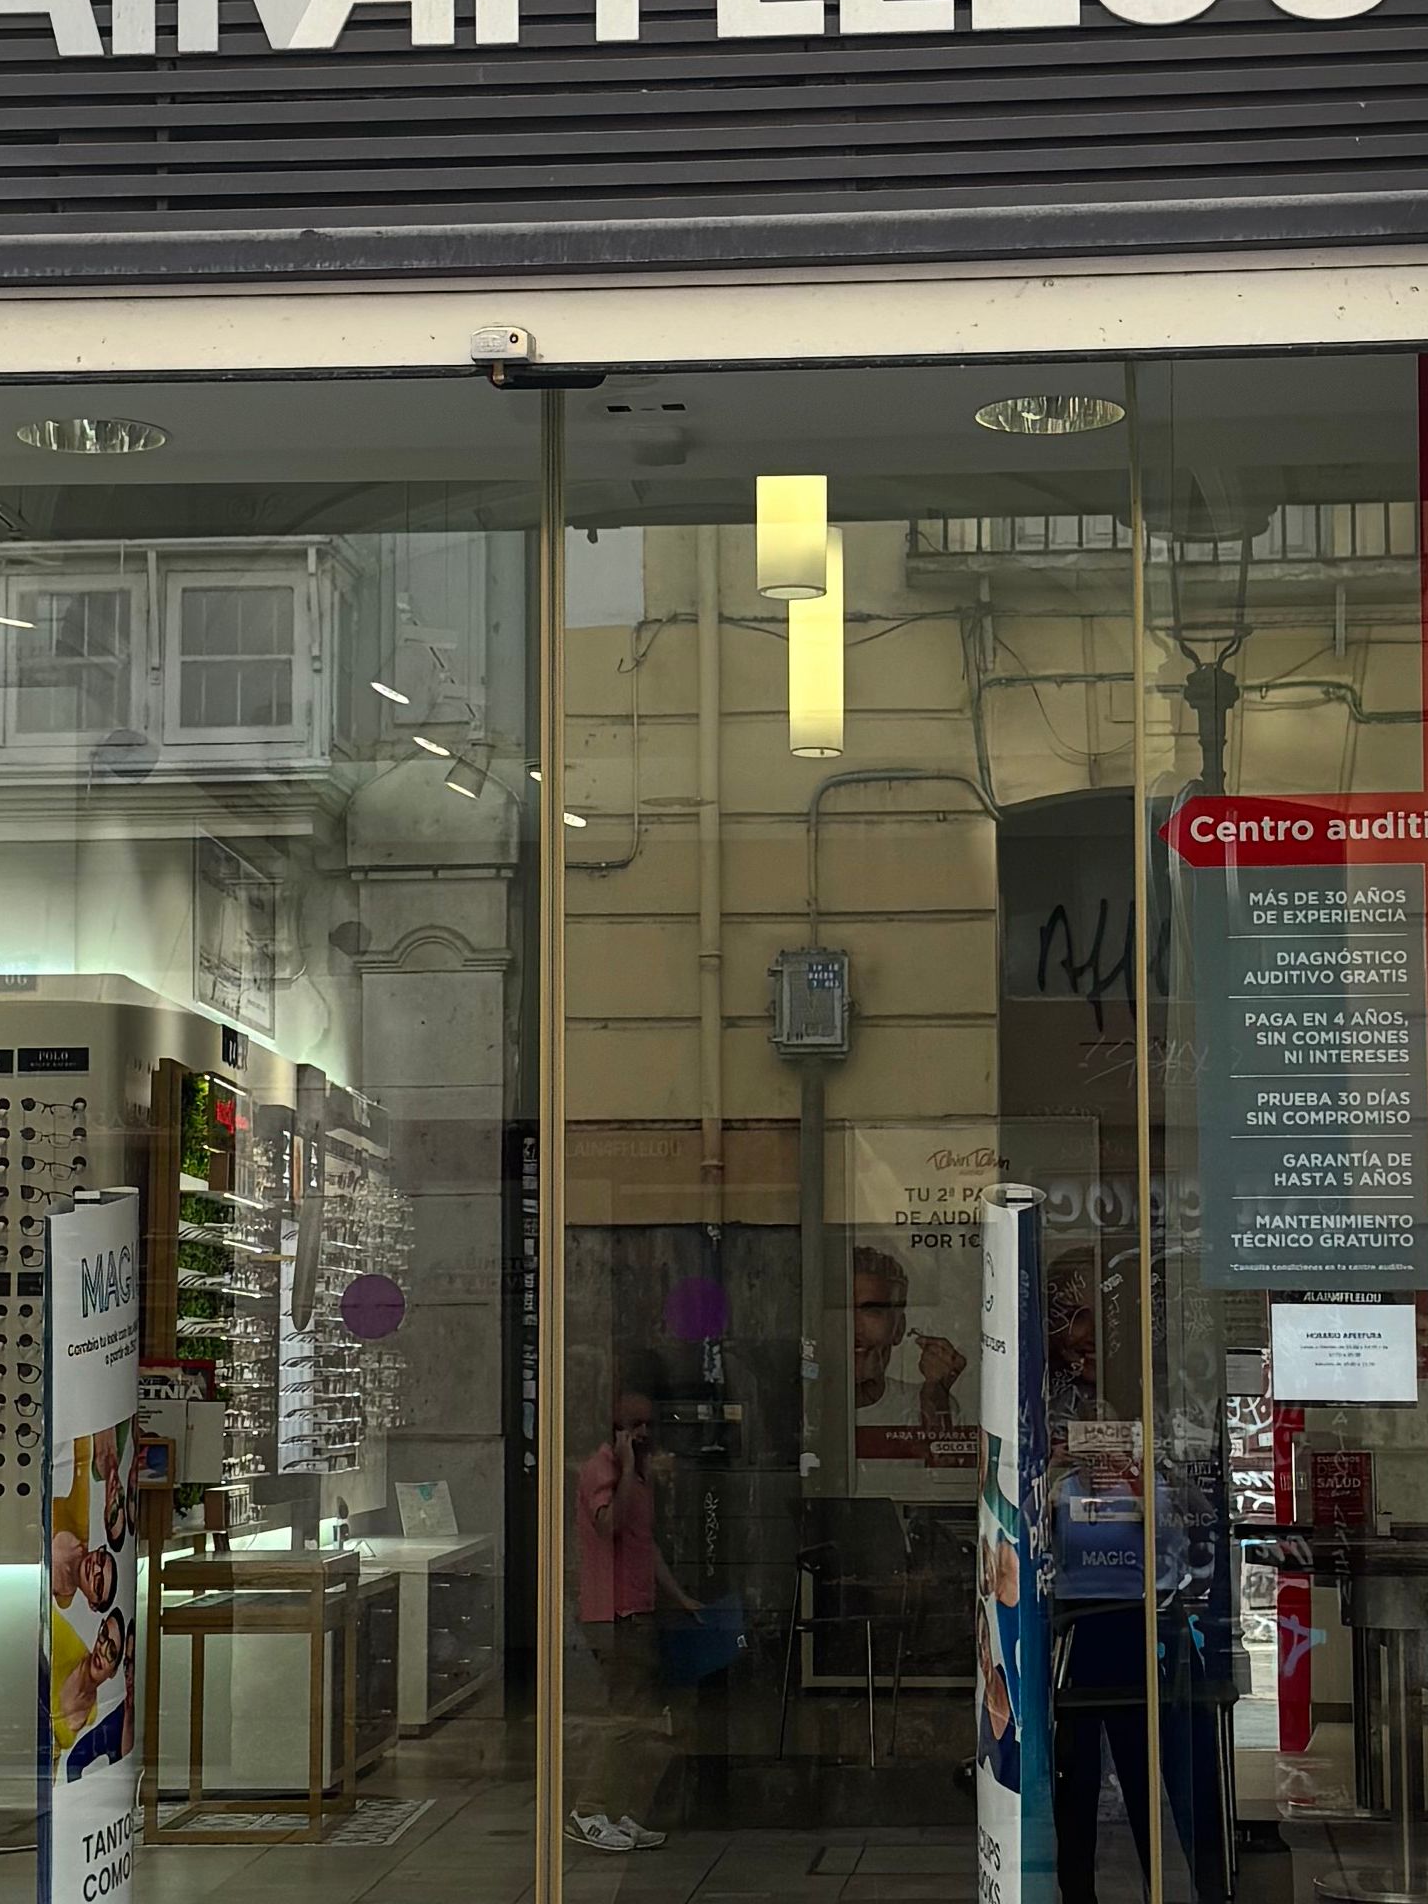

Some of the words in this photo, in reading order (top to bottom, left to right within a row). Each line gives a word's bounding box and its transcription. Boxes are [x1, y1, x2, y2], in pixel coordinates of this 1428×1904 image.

[1190, 815, 1314, 843] Centro
[1249, 889, 1288, 906] MÁS
[1294, 891, 1319, 905] DE
[1324, 891, 1348, 905] 30
[1353, 887, 1406, 904] AÑOS
[1253, 910, 1277, 924] DE
[1283, 909, 1407, 924] EXPERIENCIA
[1276, 947, 1407, 966] DIAGNÓSTICO
[1244, 970, 1333, 985] AUDITIVO
[1340, 969, 1408, 984] GRATIS
[1245, 1013, 1297, 1027] PAGA
[1303, 1013, 1327, 1026] EN
[1333, 1013, 1344, 1026] 4
[1351, 1008, 1409, 1027] AÑOS,
[1256, 1032, 1286, 1046] SIN
[1292, 1030, 1409, 1046] COMISIONES
[38, 1050, 69, 1062] POLO
[1284, 1051, 1304, 1065] NI
[1309, 1049, 1410, 1064] INTERESES
[1257, 1092, 1331, 1106] PRUEBA
[1338, 1092, 1361, 1106] 30
[1367, 1089, 1410, 1106] DÍAS
[1246, 1111, 1277, 1125] SIN
[1283, 1110, 1410, 1125] COMPROMISO
[1283, 1150, 1381, 1168] GARANTÍA
[1387, 1153, 1412, 1167] DE
[1274, 1173, 1337, 1187] HASTA
[1343, 1172, 1354, 1186] 5
[1359, 1169, 1412, 1186] AÑOS
[905, 1188, 930, 1202] TU
[963, 1187, 983, 1202] PA
[896, 1211, 919, 1226] DE
[927, 1208, 980, 1226] AUDÍ
[1256, 1214, 1413, 1229] MANTENIMIENTO
[911, 1234, 953, 1249] POR
[1231, 1230, 1314, 1248] TÉCNICO
[1320, 1233, 1414, 1248] GRATUITO
[886, 1432, 913, 1440] PARA
[1317, 1477, 1361, 1488] SALUD
[1082, 1551, 1136, 1566] MAGIC
[82, 1811, 131, 1863] TANTO
[83, 1851, 131, 1903] COMO
